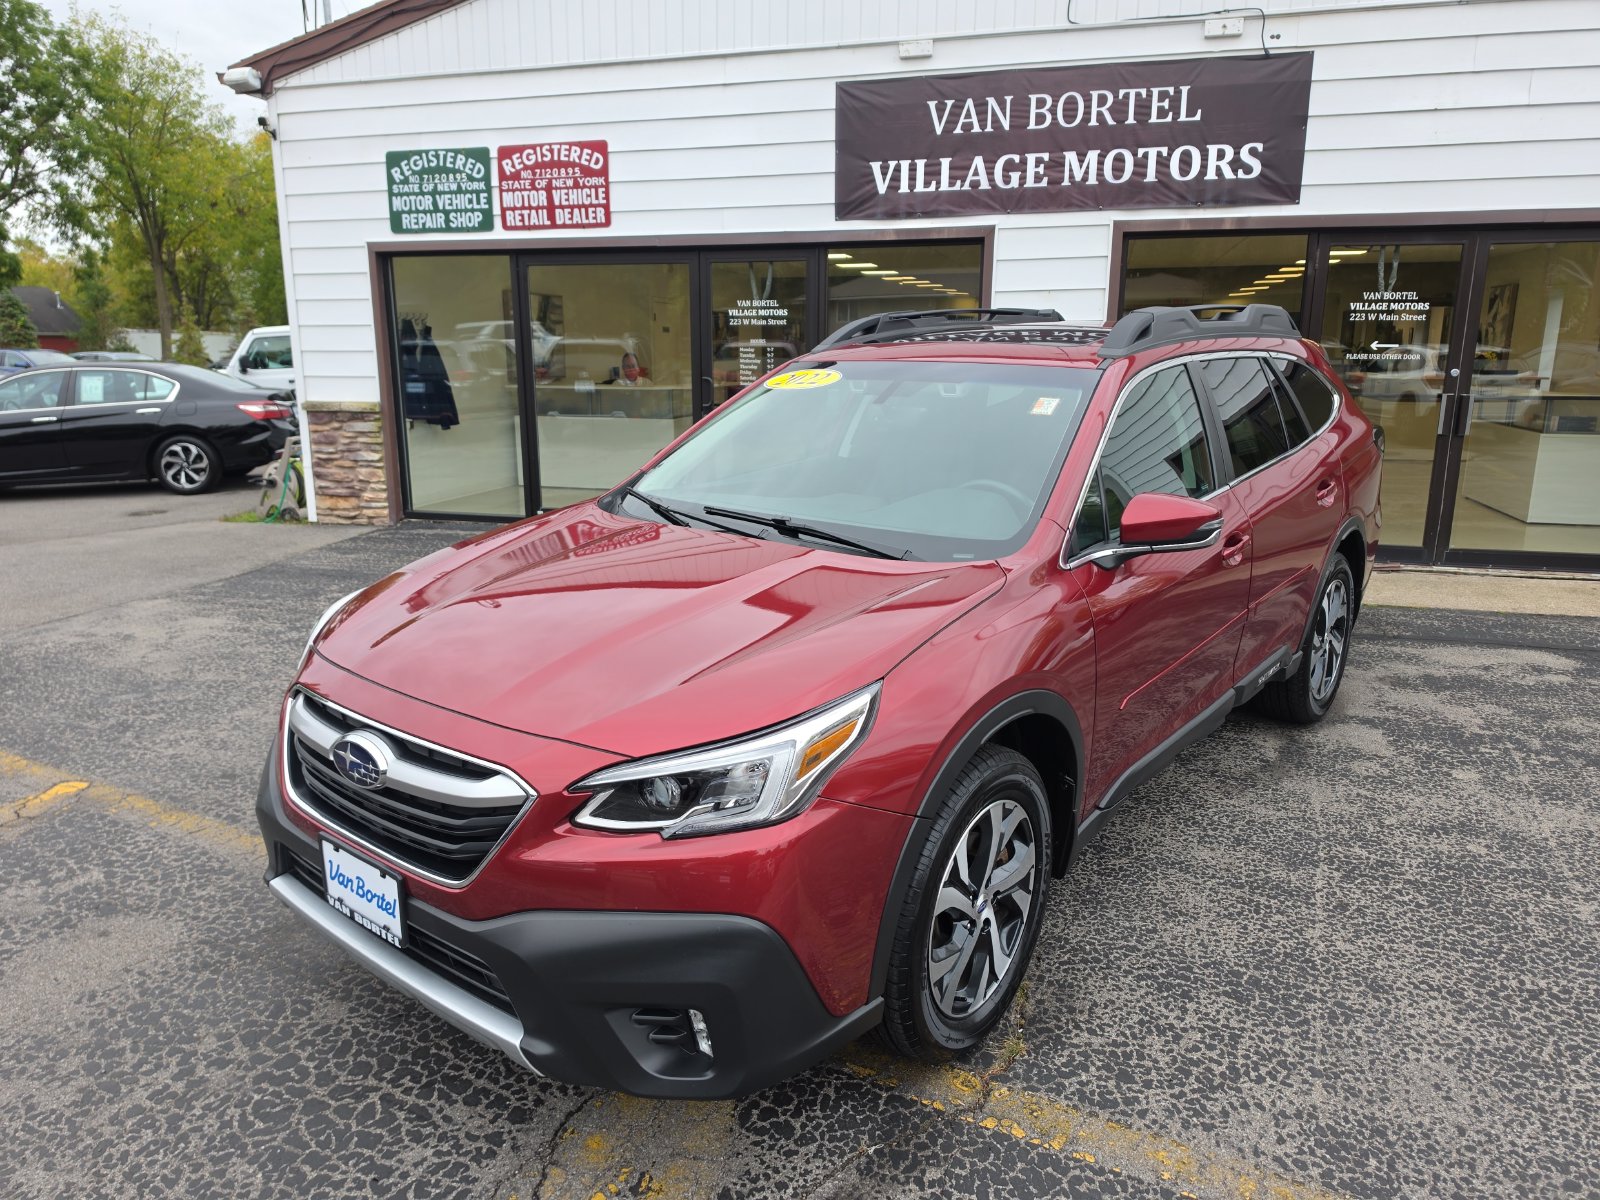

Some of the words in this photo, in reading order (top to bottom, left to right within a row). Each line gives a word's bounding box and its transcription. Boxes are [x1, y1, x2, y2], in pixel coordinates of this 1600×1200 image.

[926, 96, 1013, 136] VAN
[1026, 85, 1202, 130] BORTEL
[390, 150, 485, 183] REGISTERED
[501, 144, 604, 176] REGISTERED
[868, 153, 1050, 195] VILLAGE
[1060, 142, 1265, 186] MOTORS
[422, 173, 468, 184] 7120895
[534, 167, 581, 178] 7120895
[392, 184, 420, 193] STATE
[422, 183, 434, 192] OF
[437, 182, 458, 191] NEW
[460, 181, 486, 190] YORK
[501, 180, 531, 190] STATE
[535, 179, 548, 189] OF
[552, 178, 573, 188] NEW
[578, 177, 606, 187] YORK
[392, 195, 433, 211] MOTOR
[436, 193, 489, 210] VEHICLE
[502, 190, 547, 208] MOTOR
[552, 187, 606, 206] VEHICLE
[402, 213, 445, 229] REPAIR
[449, 211, 483, 228] SHOP
[506, 209, 551, 227] RETAIL
[555, 207, 605, 225] DEALER
[1363, 291, 1381, 300] VAN
[1383, 291, 1419, 300] BORTEL
[728, 309, 758, 317] VILLAGE
[758, 309, 788, 317] MOTORS
[1350, 302, 1388, 311] VILLAGE
[1389, 302, 1430, 311] MOTORS
[1349, 313, 1366, 321] 223
[1367, 313, 1377, 321] W
[1378, 313, 1399, 321] Main
[1400, 313, 1427, 321] Street
[355, 876, 396, 919] Bortel
[327, 894, 351, 917] VAN
[354, 911, 401, 948] BORTEL
